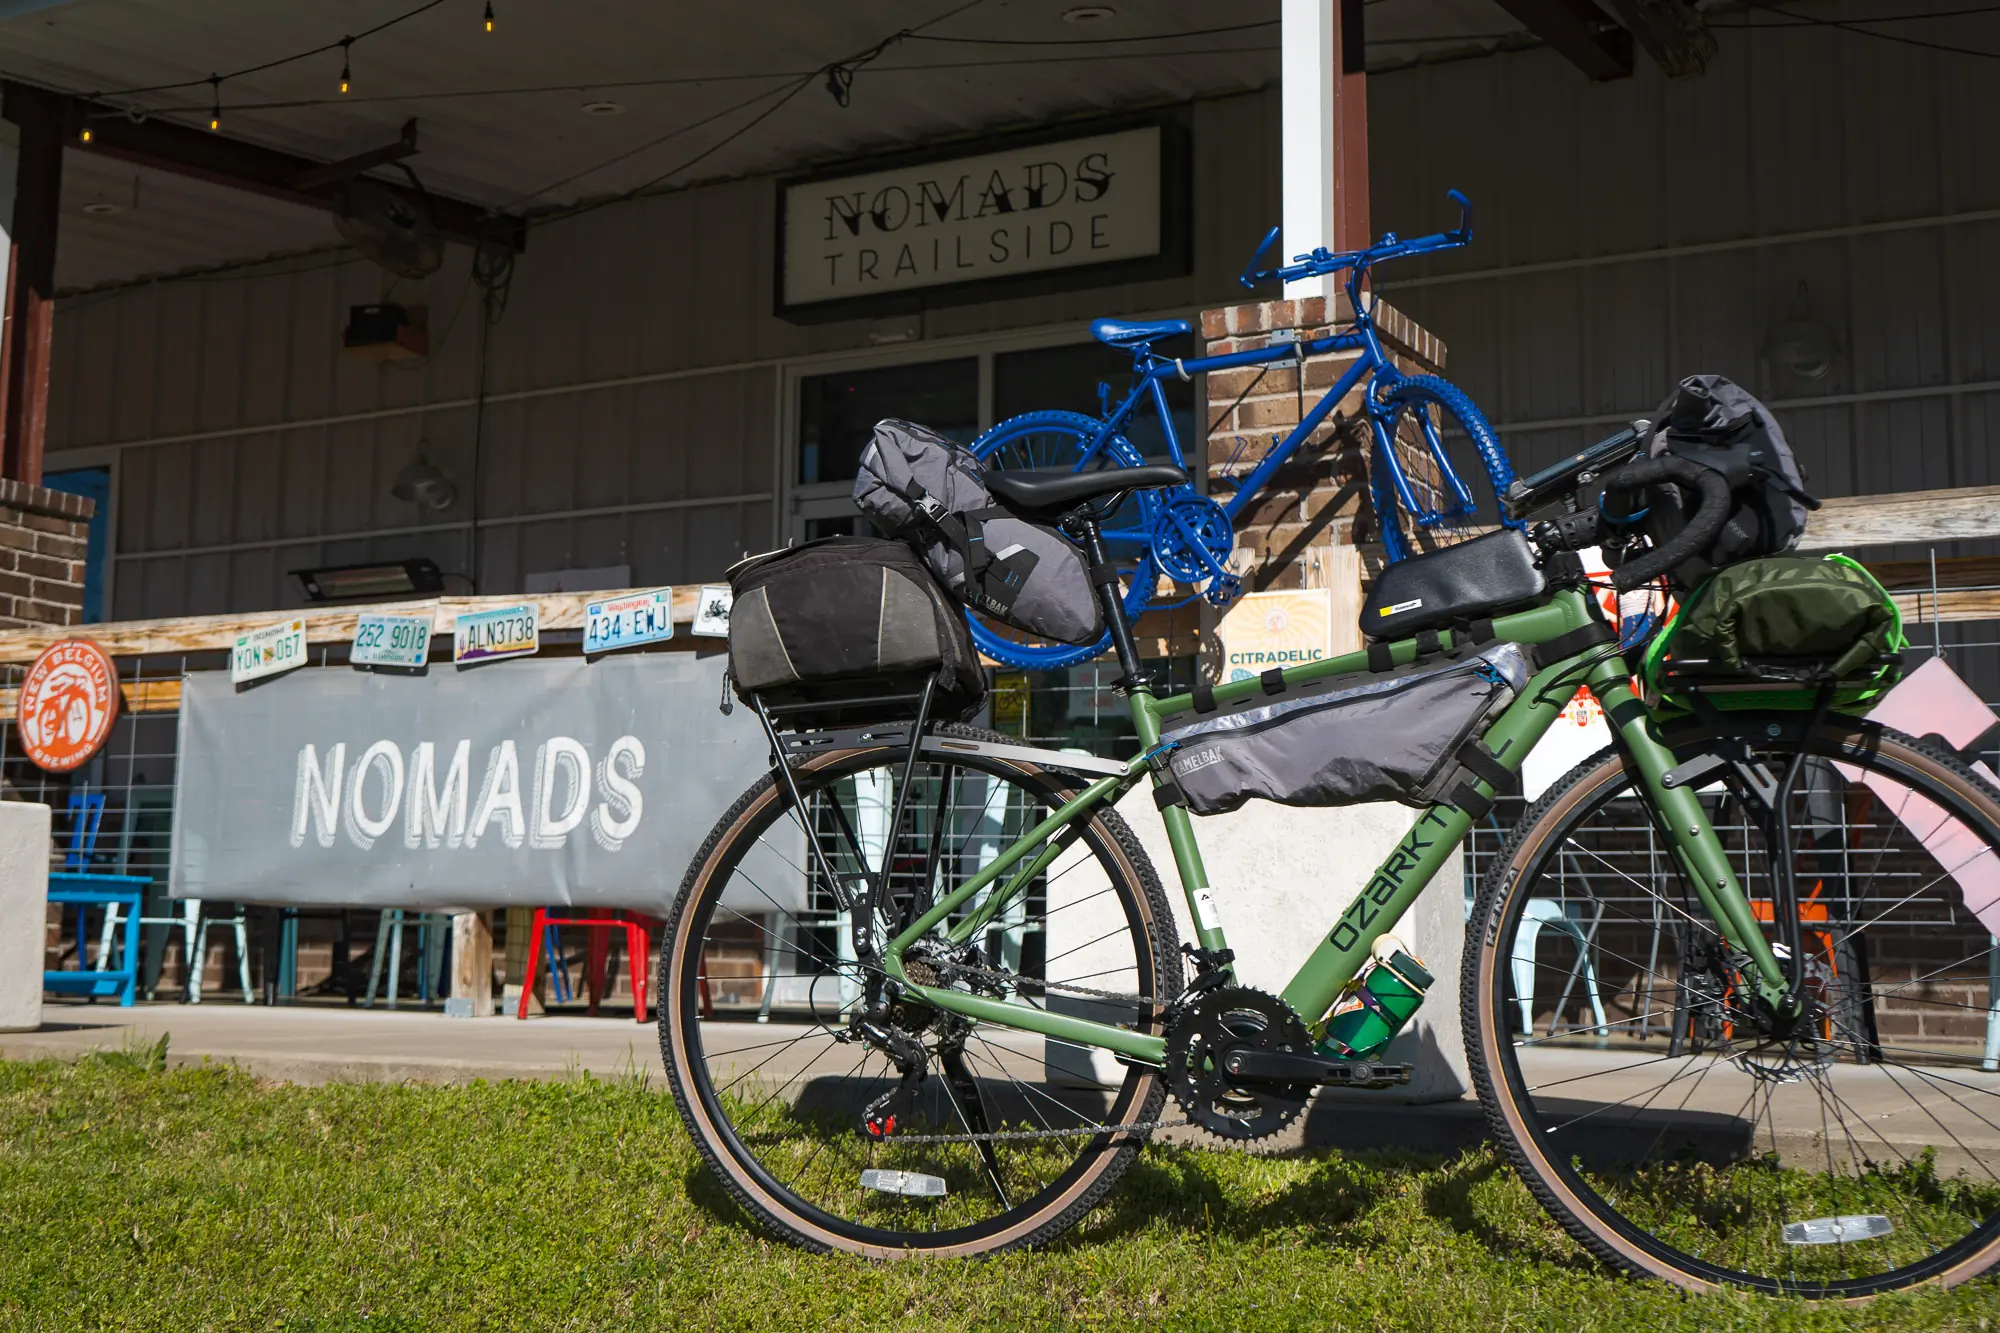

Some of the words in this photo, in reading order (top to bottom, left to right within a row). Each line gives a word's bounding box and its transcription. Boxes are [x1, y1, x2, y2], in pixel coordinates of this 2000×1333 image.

[823, 153, 1116, 240] NOMADS
[824, 214, 1111, 286] TRAILSIDE
[277, 634, 300, 660] 067
[356, 623, 385, 648] 252
[391, 625, 427, 650] 9018
[468, 616, 534, 649] ALN3738
[1230, 648, 1323, 665] CITRADELIC
[25, 665, 48, 711] NEW
[52, 648, 107, 703] BELGIUM
[34, 742, 93, 768] BREWING
[1174, 746, 1225, 776] CAMELBAK
[291, 734, 646, 851] NOMADS
[1486, 867, 1520, 948] KENDA
